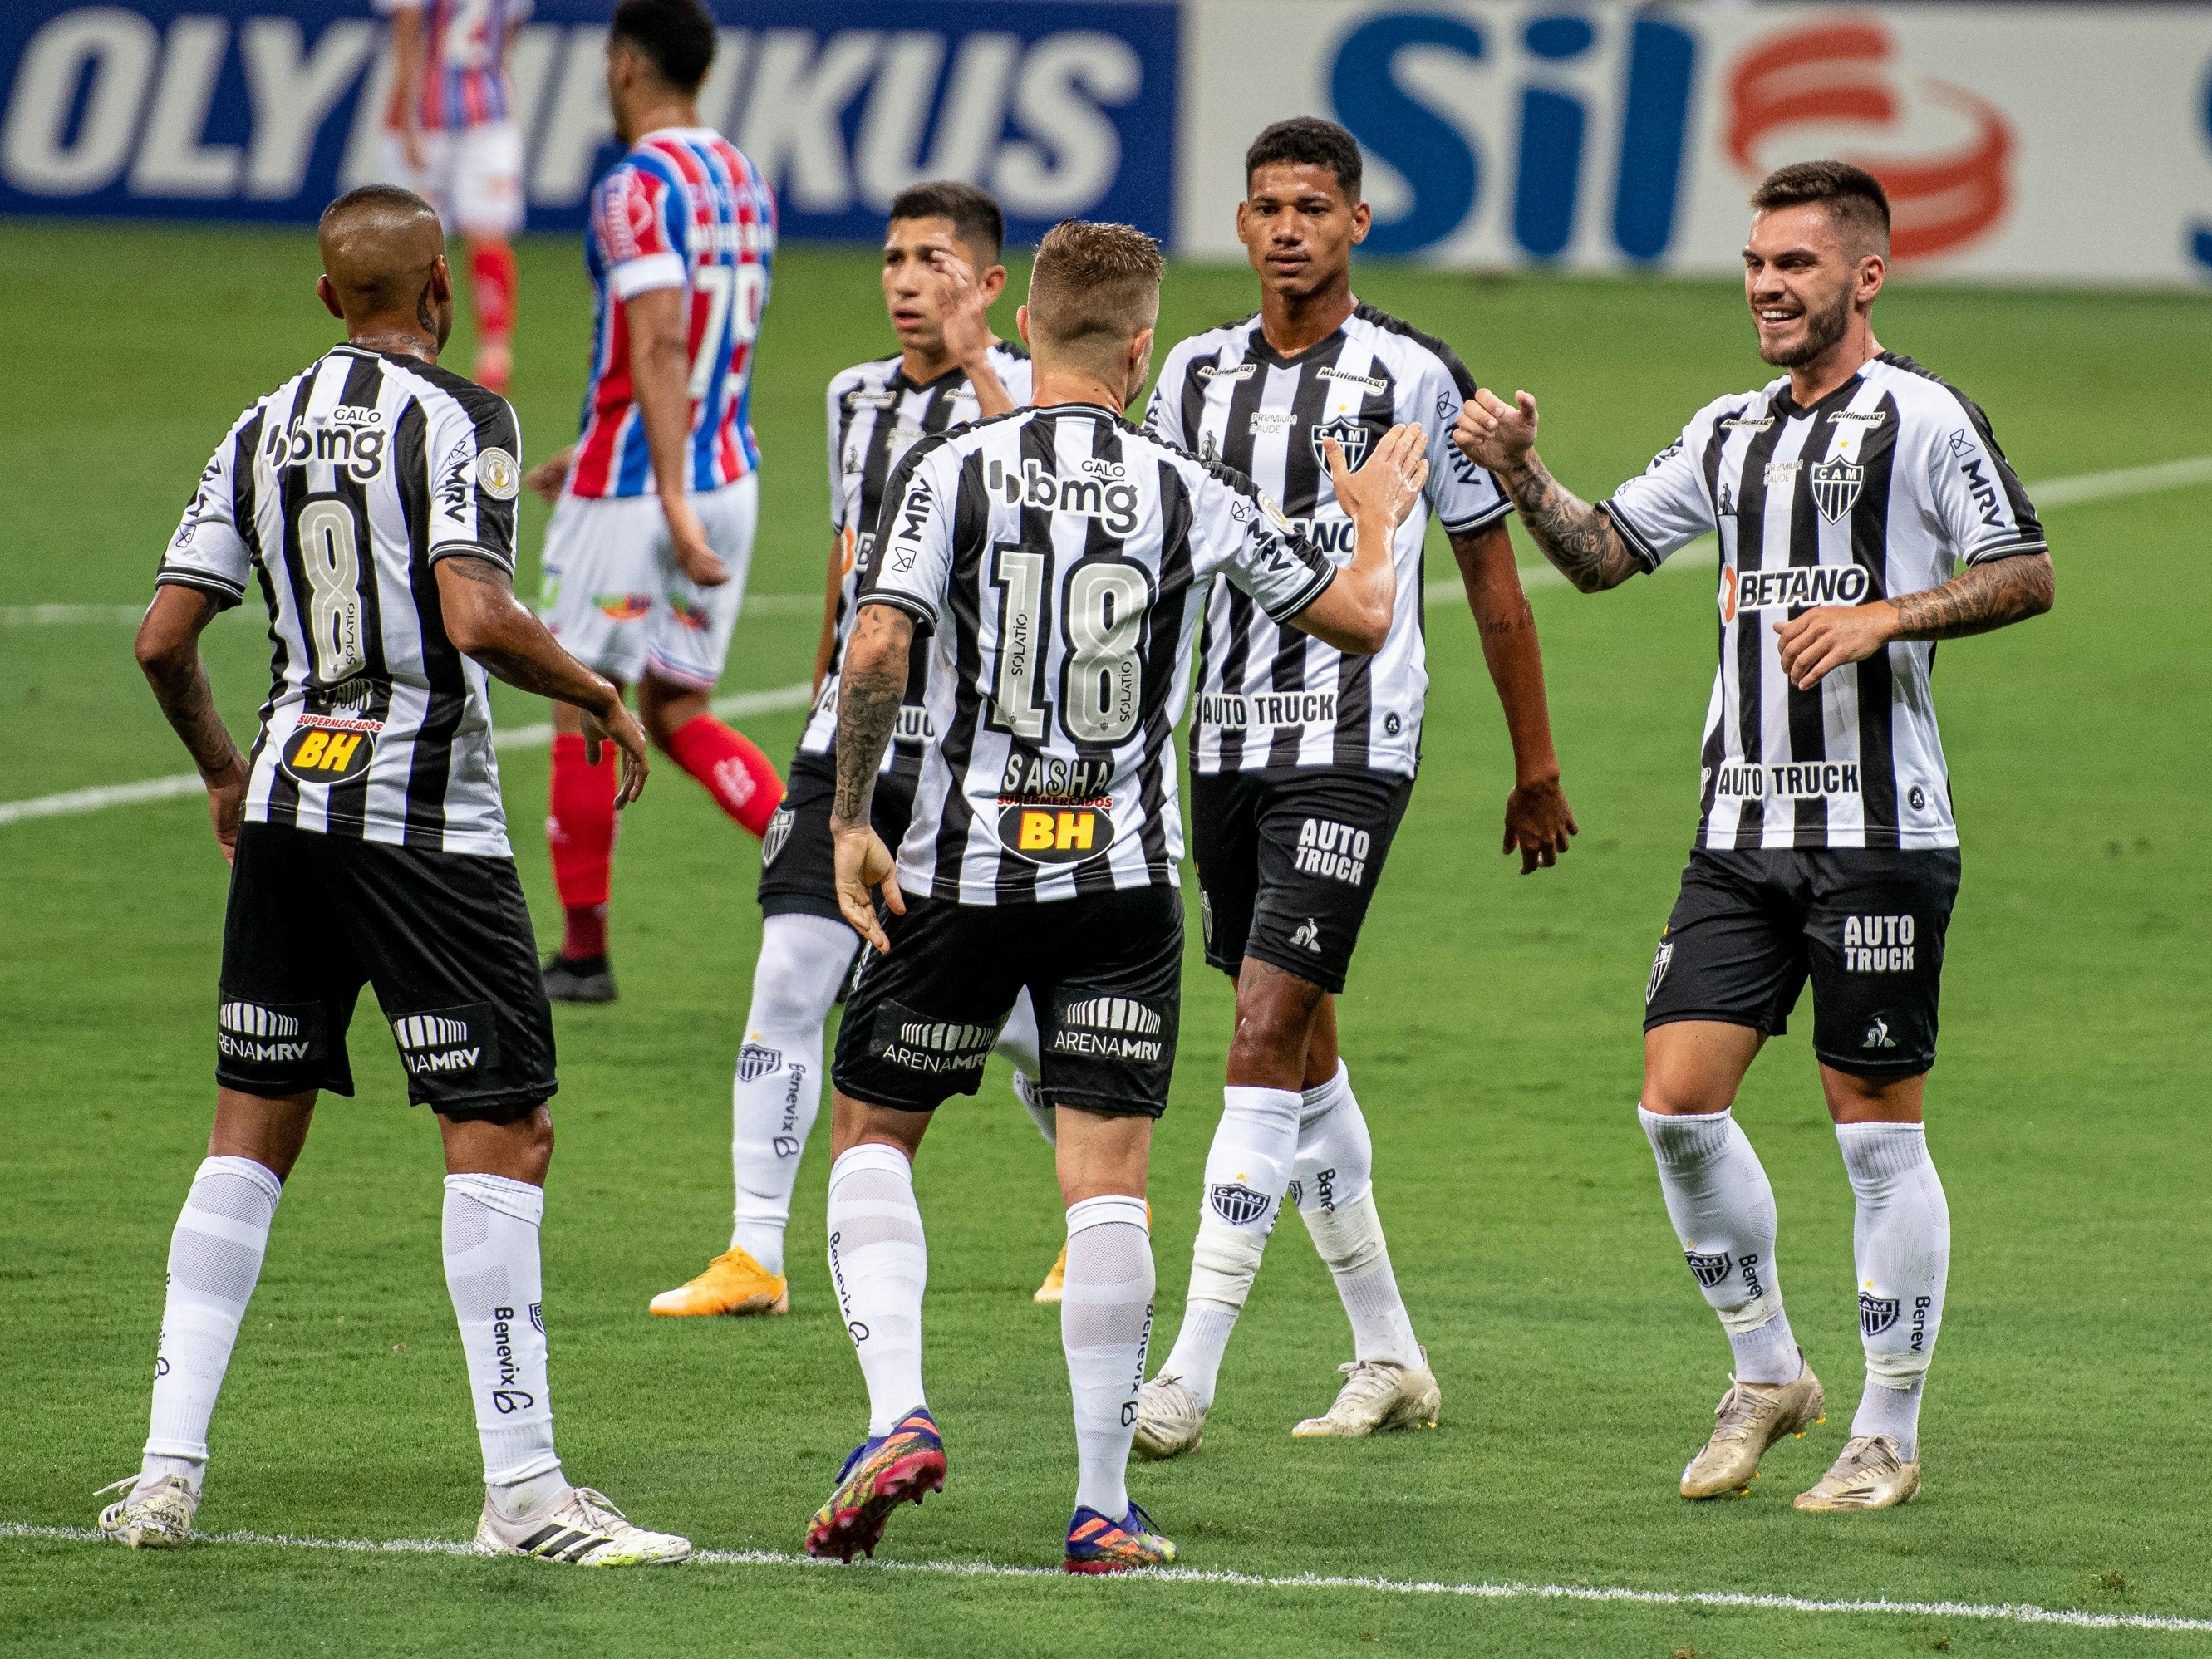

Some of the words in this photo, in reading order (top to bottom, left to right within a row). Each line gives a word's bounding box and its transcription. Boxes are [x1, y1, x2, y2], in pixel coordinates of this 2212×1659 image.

[1326, 10, 1698, 261] Sil
[1320, 368, 1387, 388] Multimarcas
[333, 408, 381, 425] GALO
[1319, 429, 1361, 442] CAM
[1832, 410, 1886, 421] Multimarcas
[291, 422, 385, 480] bmg
[1081, 459, 1126, 478] GALO
[444, 462, 470, 524] MRV
[1818, 468, 1857, 480] CAM
[1960, 458, 2006, 528] MRV
[898, 476, 933, 542] MRV
[1027, 462, 1138, 533] bmg
[1246, 518, 1294, 572] MRV
[297, 498, 366, 683] 8
[1739, 567, 1865, 608] BETANO
[993, 551, 1149, 741] 18
[297, 715, 384, 732] SUPERMERCADOS
[1203, 695, 1247, 725] AUTO
[1254, 693, 1335, 724] TRUCK
[292, 729, 363, 772] BH
[1004, 753, 1108, 796] SASHA
[1718, 767, 1763, 795] AUTO
[1771, 763, 1859, 795] TRUCK
[997, 794, 1113, 808] SUPERMERCADOS
[1017, 810, 1095, 850] BH
[1298, 817, 1370, 860] AUTO
[1294, 846, 1365, 886] TRUCK
[1843, 915, 1915, 946] AUTO
[1843, 946, 1915, 971] TRUCK
[219, 1032, 309, 1062] RENAMRV
[883, 1043, 986, 1073] ARENAMR
[781, 1063, 806, 1131] Benevix
[1217, 1187, 1261, 1204] CAM
[1317, 1167, 1336, 1212] Bene
[830, 1230, 851, 1319] Benevix
[1738, 1254, 1762, 1297] Bene
[1910, 1295, 1931, 1352] Benev
[494, 1306, 520, 1387] Benevix
